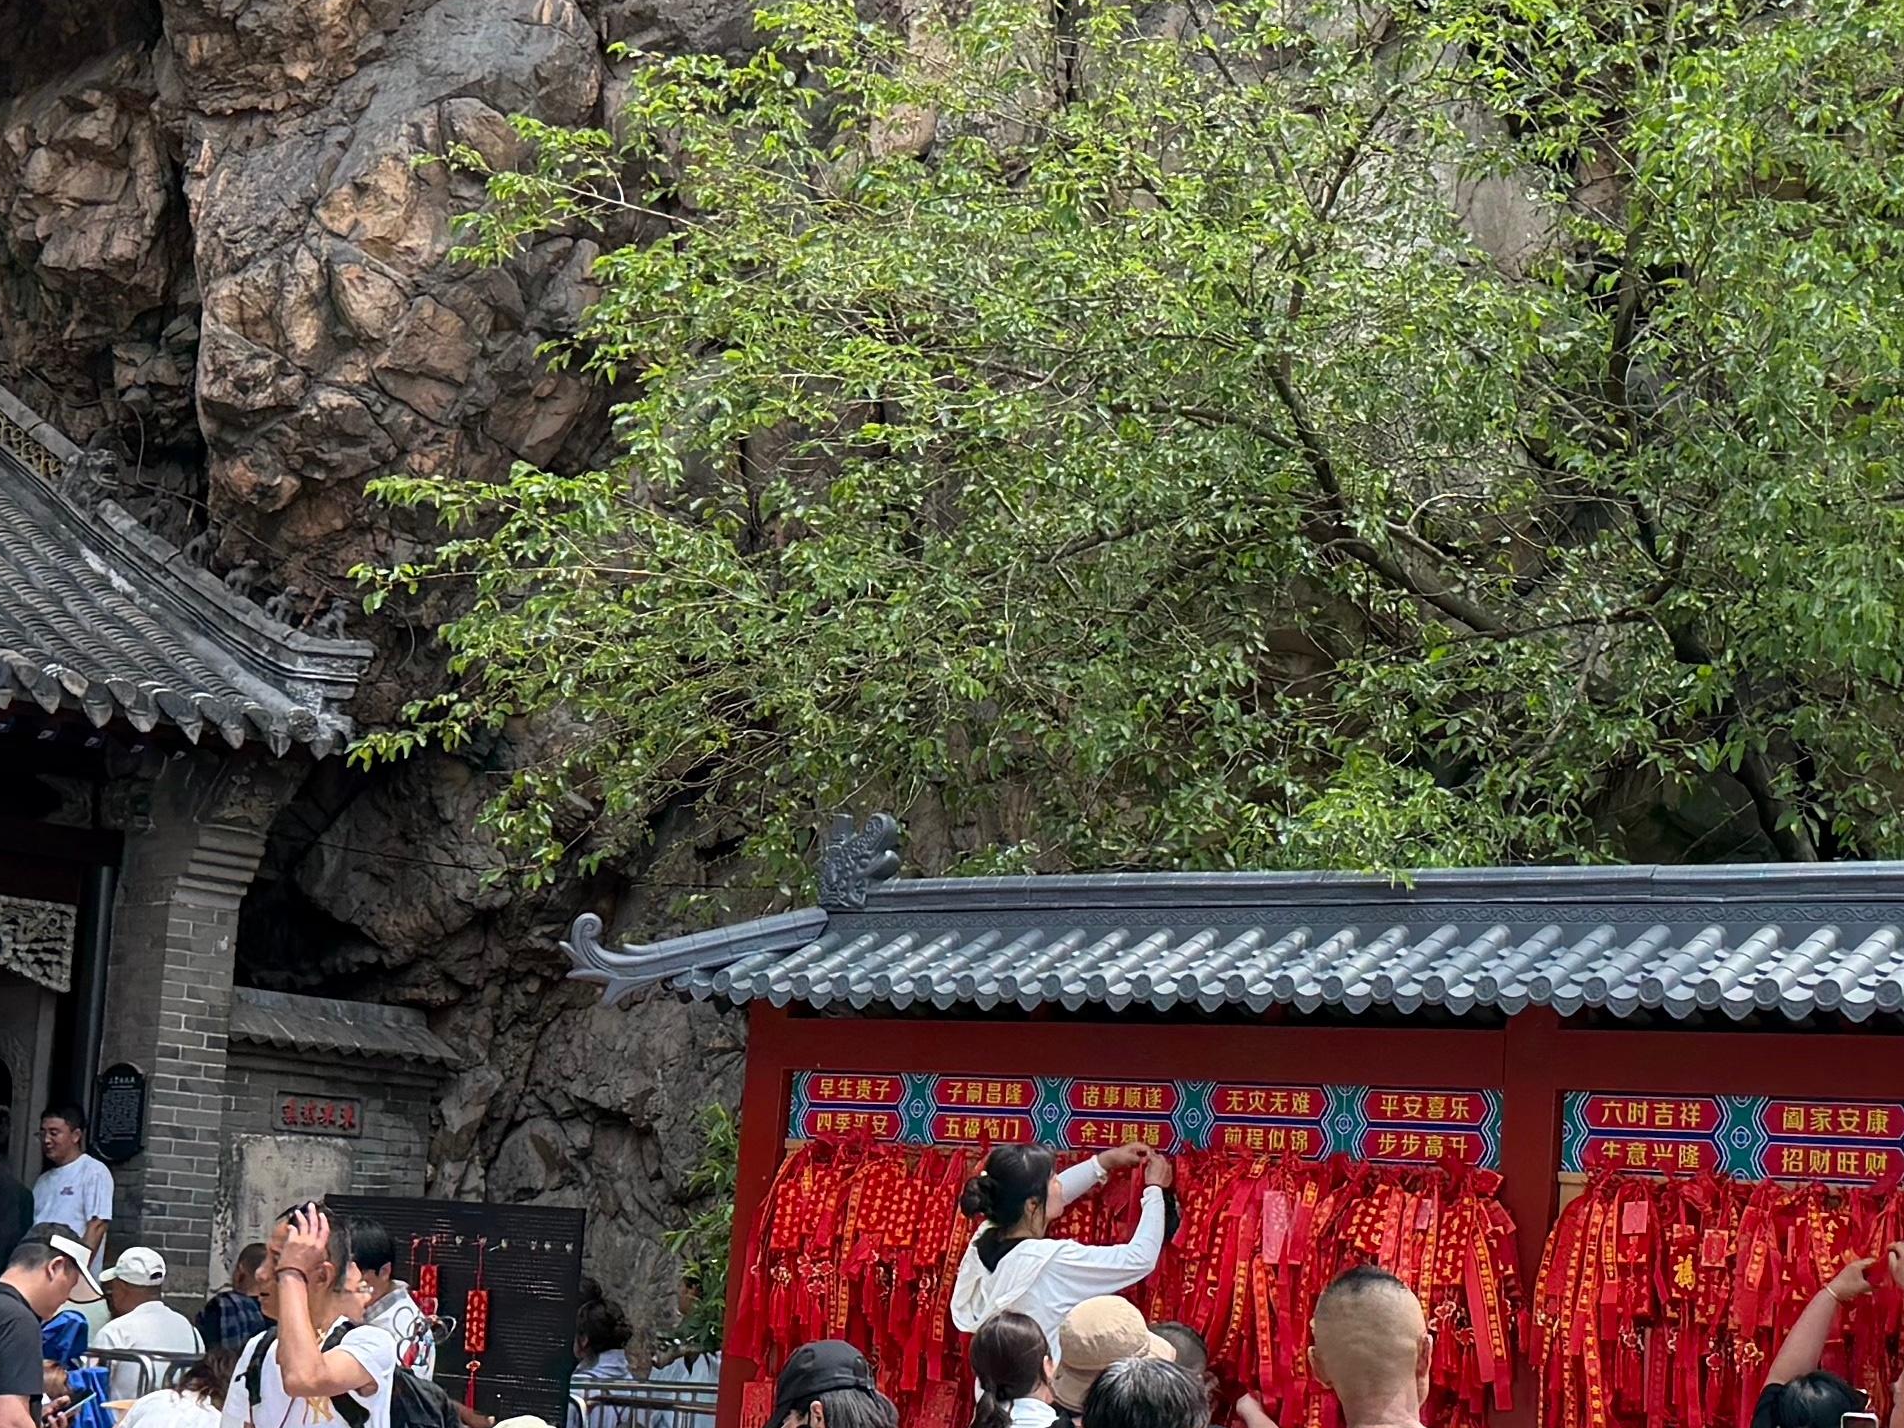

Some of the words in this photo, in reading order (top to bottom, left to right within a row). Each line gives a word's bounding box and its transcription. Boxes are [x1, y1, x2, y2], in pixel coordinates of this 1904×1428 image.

[818, 1078, 891, 1103] 早生贵子
[947, 1081, 1023, 1106] 子嗣昌隆
[1082, 1084, 1163, 1110] 诸事顺遂
[1227, 1090, 1310, 1115] 无灾无难
[1380, 1094, 1470, 1120] 平安喜乐
[1601, 1100, 1701, 1128] 六时吉祥
[816, 1112, 889, 1137] 四季平安
[944, 1116, 1020, 1141] 五福临门
[1782, 1106, 1889, 1135] 阖家安康
[1224, 1126, 1309, 1151] 前程似锦
[1378, 1134, 1468, 1160] 步步高升
[1601, 1141, 1701, 1169] 生意兴隆
[1781, 1148, 1888, 1177] 招财旺财
